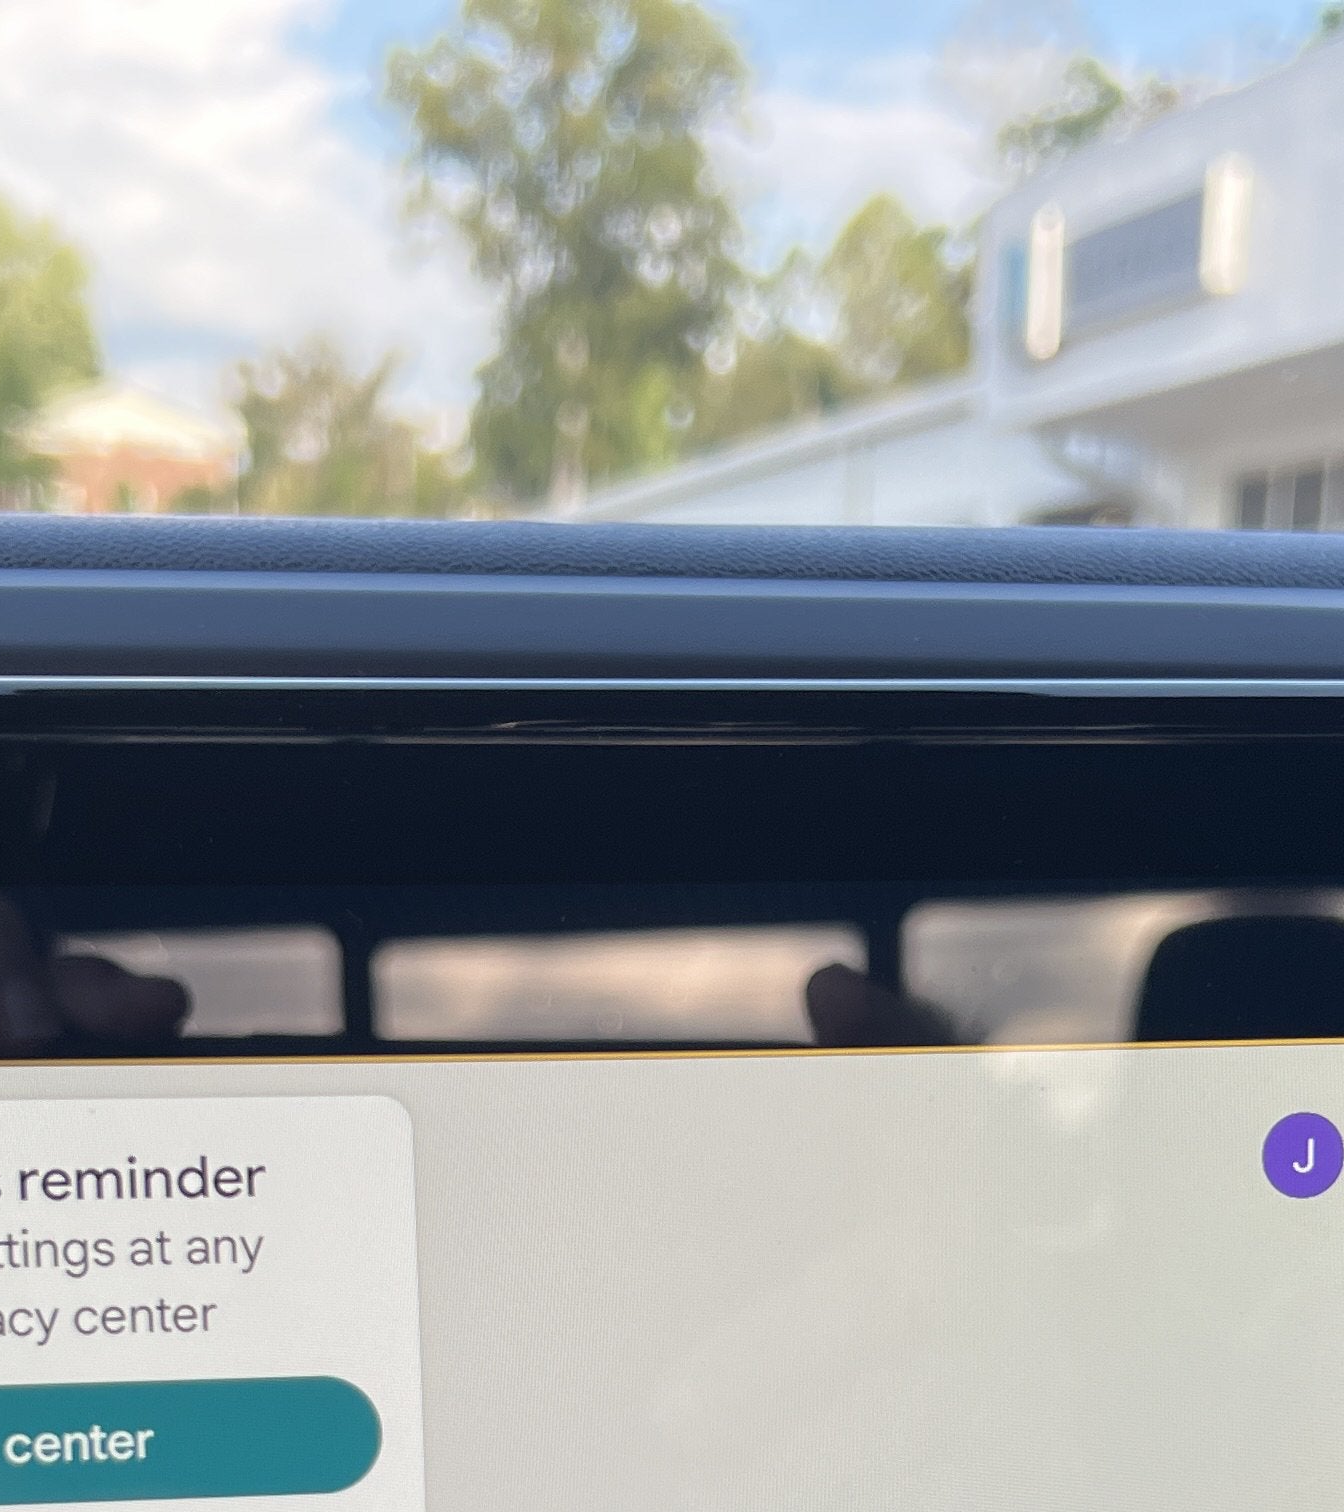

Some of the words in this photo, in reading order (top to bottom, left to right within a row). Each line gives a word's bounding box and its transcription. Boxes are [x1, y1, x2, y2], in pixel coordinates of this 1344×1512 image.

[1292, 1138, 1315, 1174] J
[18, 1155, 266, 1203] reminder
[129, 1230, 173, 1268] at
[186, 1235, 264, 1276] any
[73, 1297, 218, 1337] center
[4, 1424, 155, 1467] center
